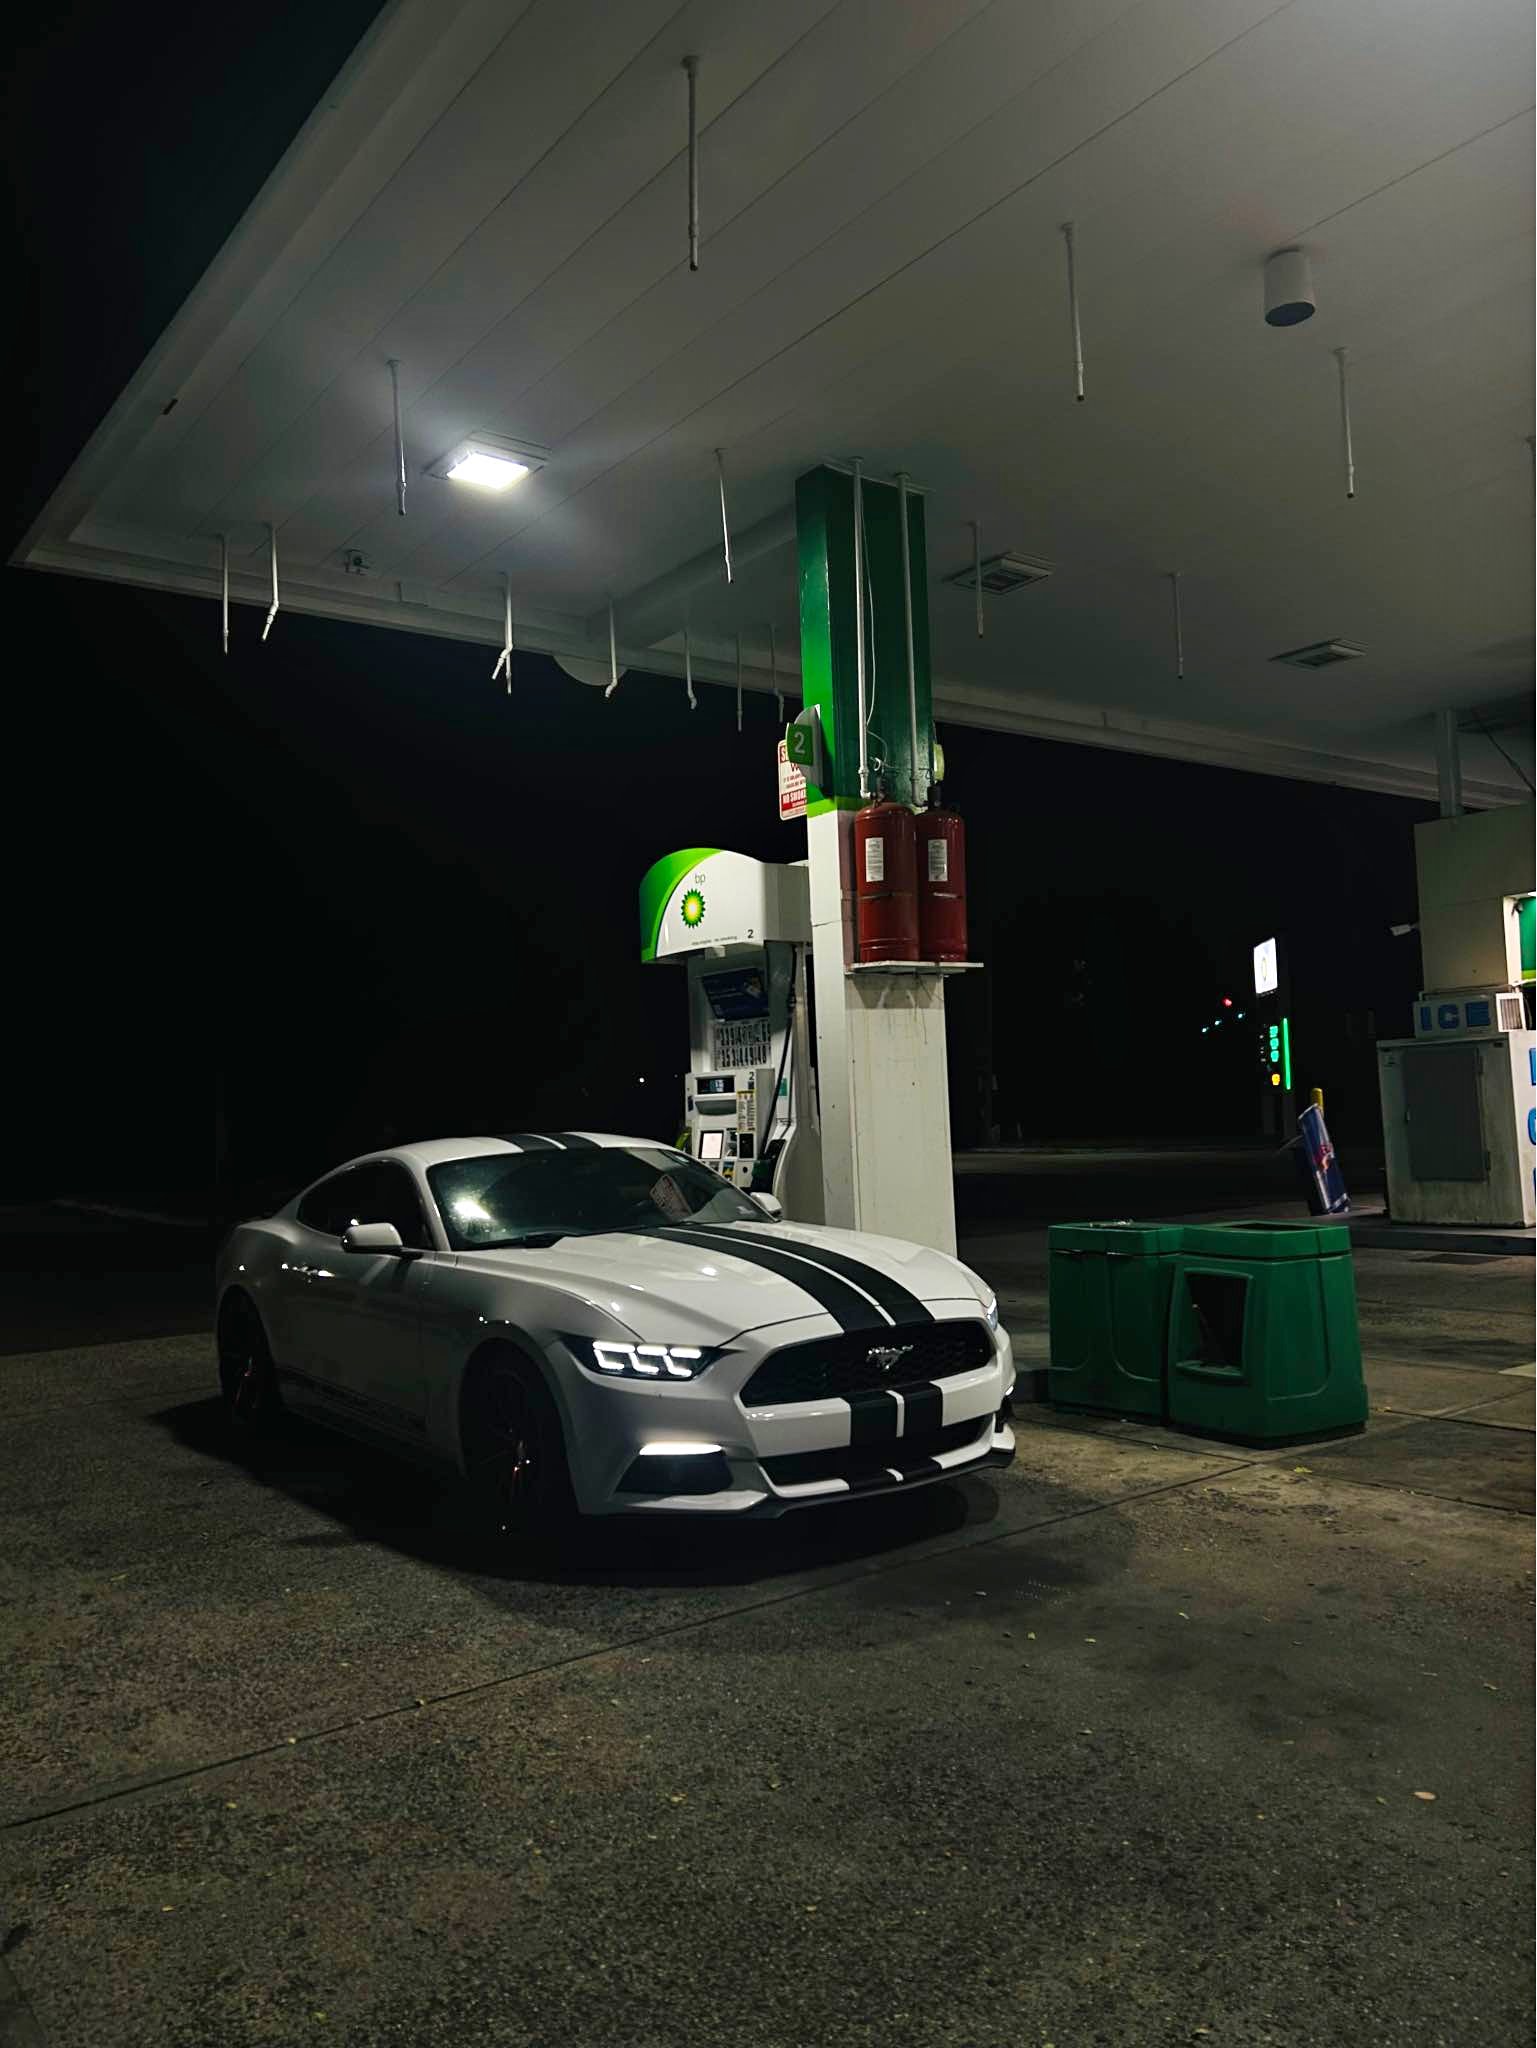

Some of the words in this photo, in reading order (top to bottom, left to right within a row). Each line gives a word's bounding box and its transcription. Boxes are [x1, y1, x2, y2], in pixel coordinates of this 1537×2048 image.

[794, 731, 805, 754] 2
[694, 873, 706, 886] bp
[747, 929, 754, 939] 2
[1420, 1001, 1491, 1031] ICE
[749, 1071, 755, 1080] 2
